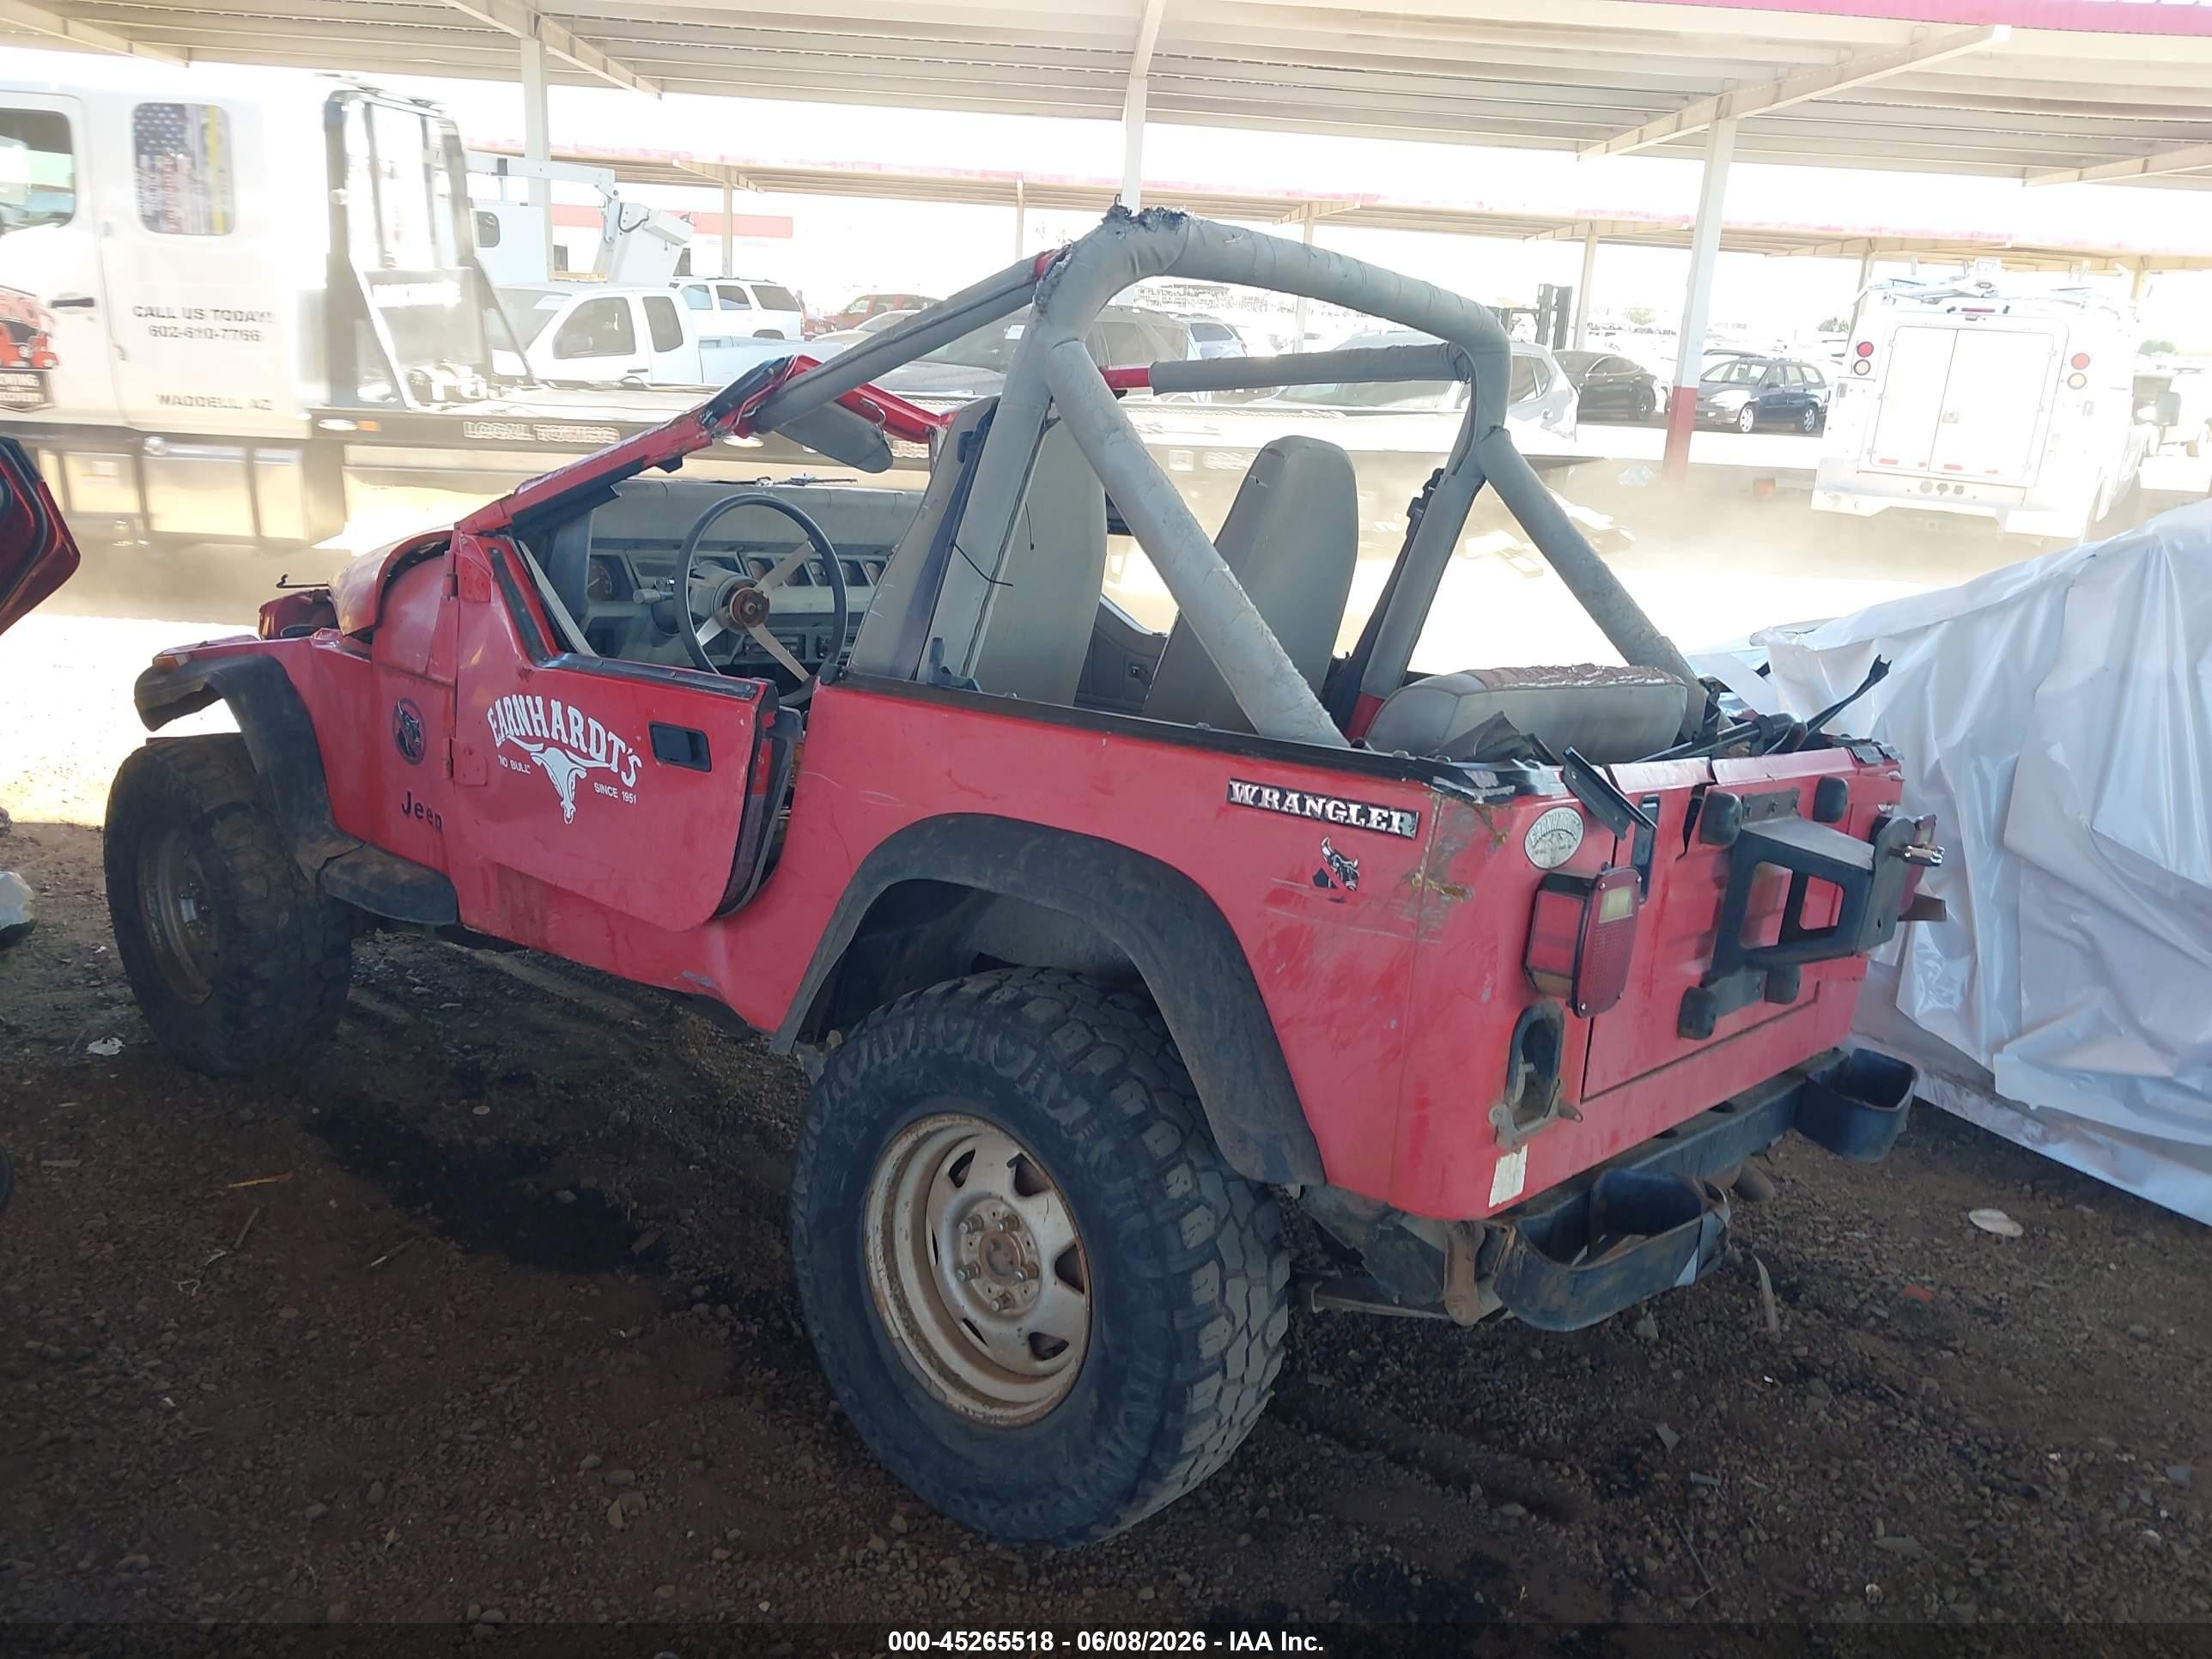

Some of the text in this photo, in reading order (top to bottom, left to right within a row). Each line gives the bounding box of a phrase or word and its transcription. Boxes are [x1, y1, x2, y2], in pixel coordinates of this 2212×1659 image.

[132, 304, 178, 320] CALL
[181, 307, 205, 321] US
[249, 398, 274, 411] AZ
[487, 694, 642, 788] EARNHARDT'S
[593, 781, 637, 805] SINCE 1951
[1229, 779, 1417, 838] WRANGLER
[401, 789, 442, 833] Jeep
